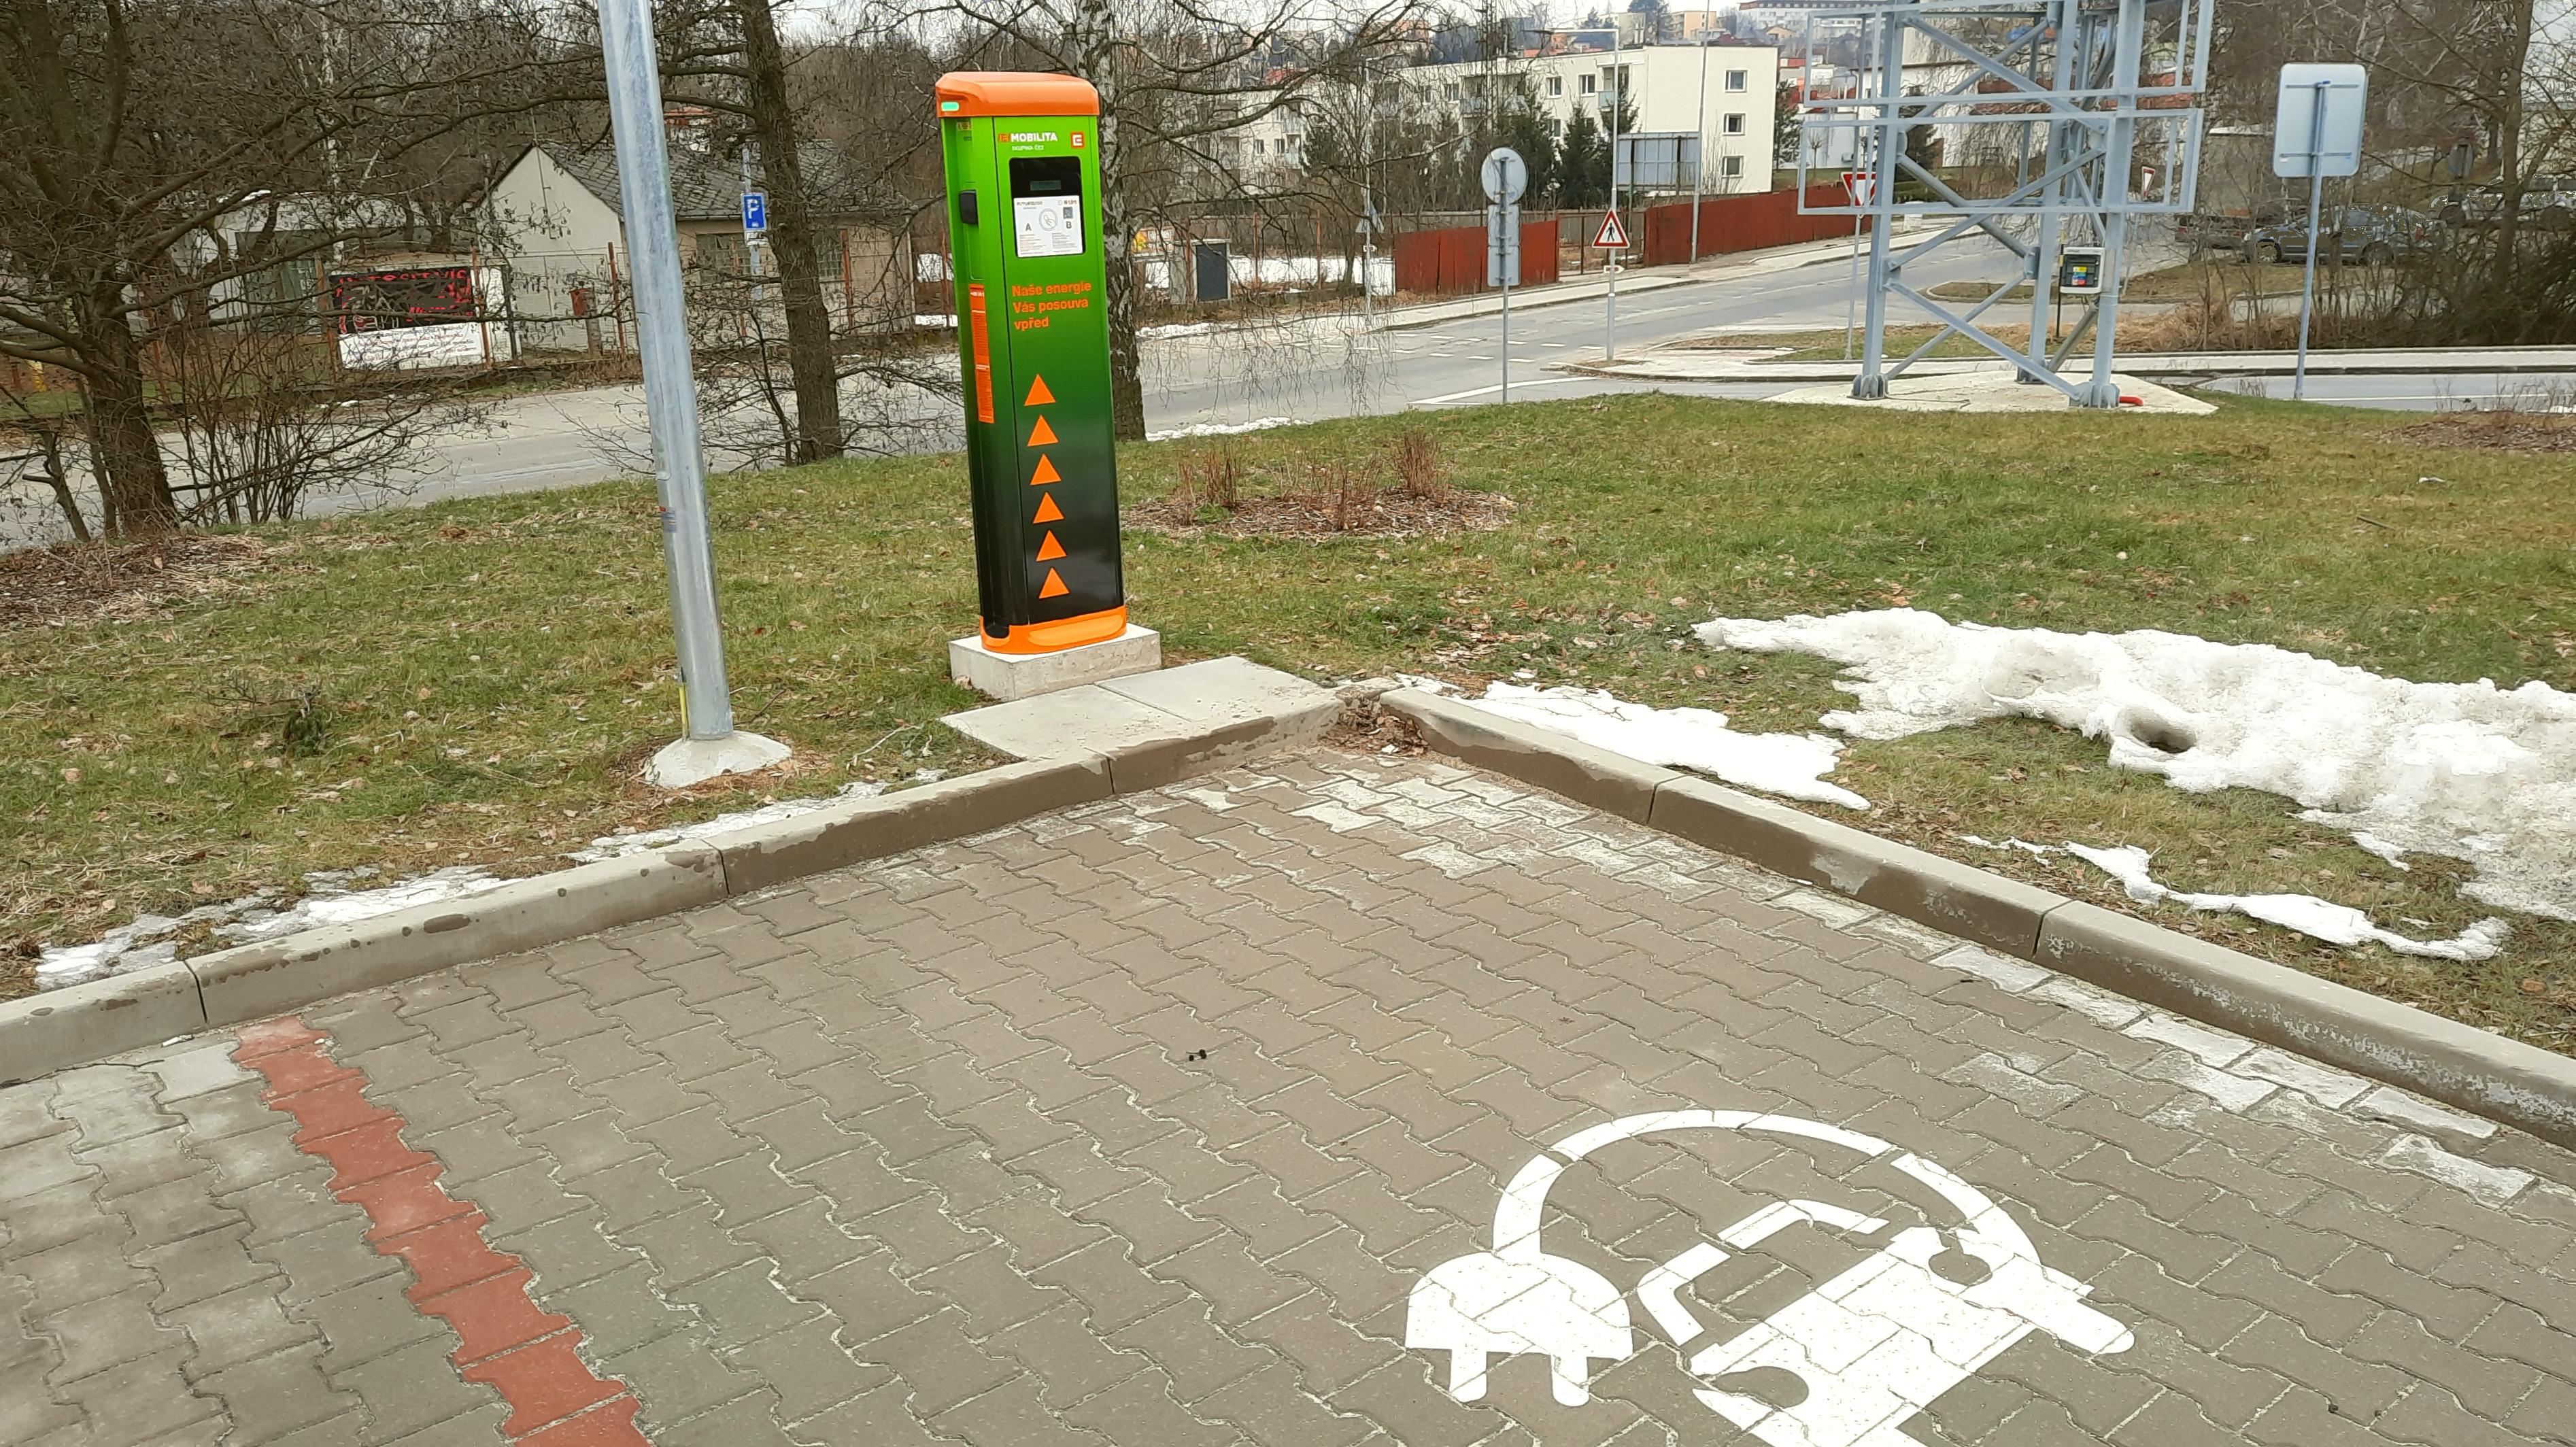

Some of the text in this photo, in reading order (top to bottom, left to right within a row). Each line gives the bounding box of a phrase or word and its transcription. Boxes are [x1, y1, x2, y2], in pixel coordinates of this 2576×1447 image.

[747, 199, 759, 219] P
[1026, 223, 1032, 231] A
[1012, 281, 1091, 296] Naše energie
[1013, 301, 1035, 313] Vás
[1014, 316, 1049, 331] vpřed
